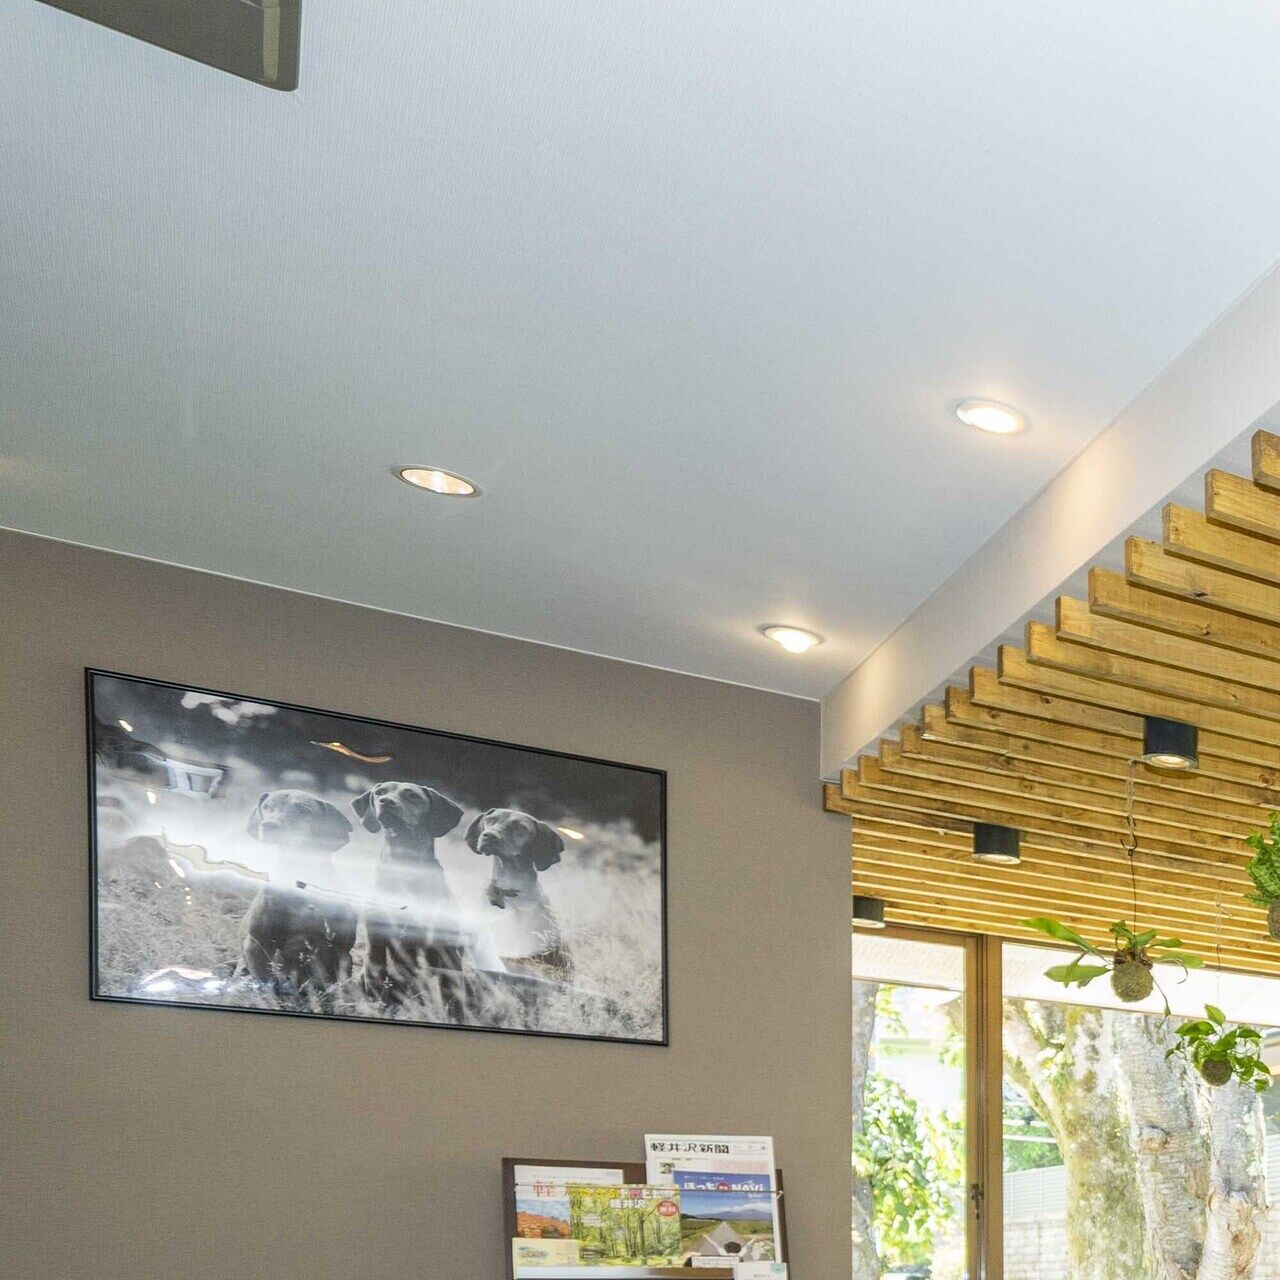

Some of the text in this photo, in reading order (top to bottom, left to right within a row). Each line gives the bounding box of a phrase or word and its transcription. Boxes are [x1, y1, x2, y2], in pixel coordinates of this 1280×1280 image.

[650, 1142, 729, 1154] 軽井沢新聞
